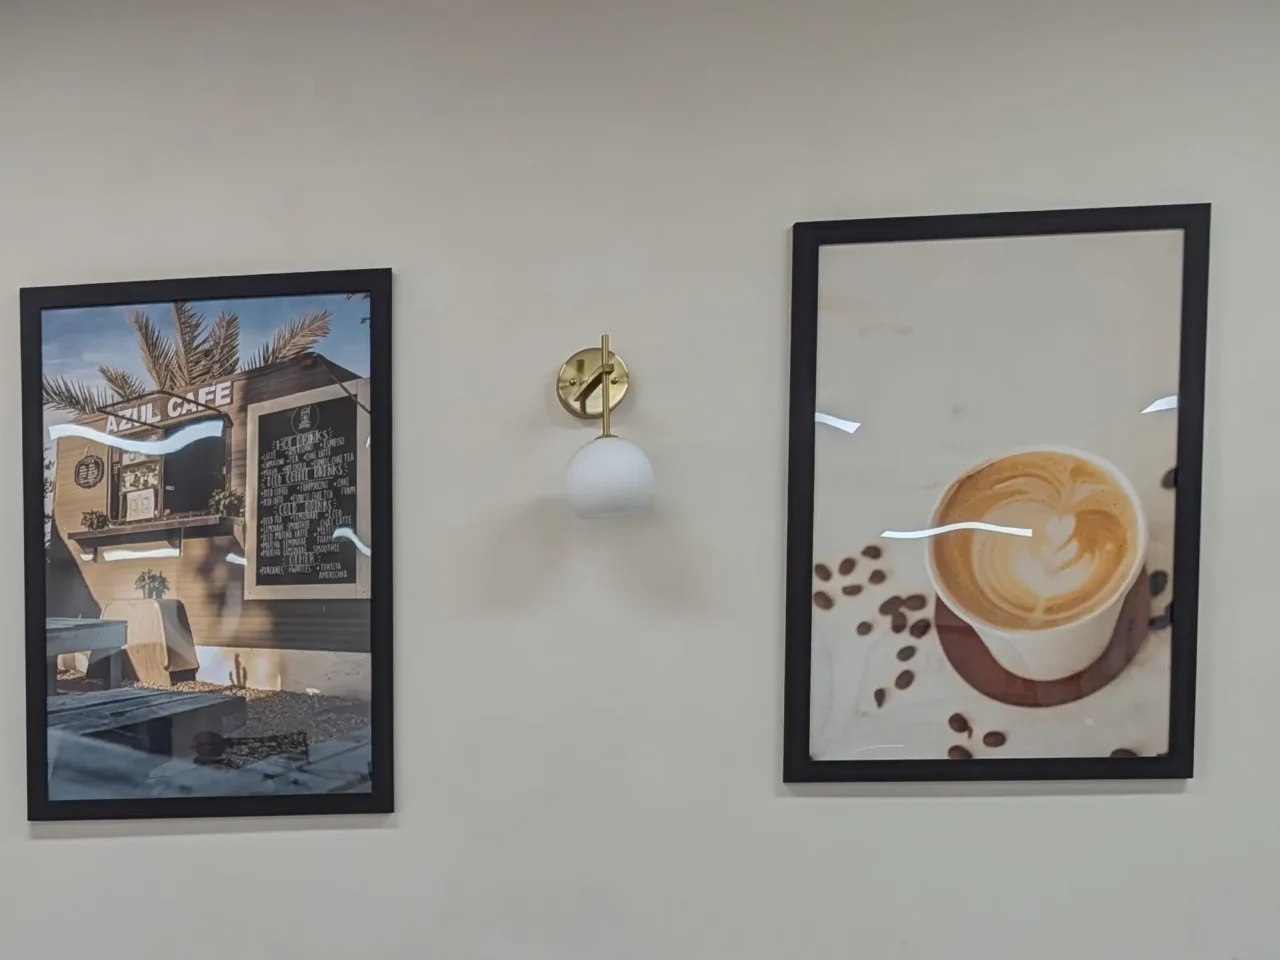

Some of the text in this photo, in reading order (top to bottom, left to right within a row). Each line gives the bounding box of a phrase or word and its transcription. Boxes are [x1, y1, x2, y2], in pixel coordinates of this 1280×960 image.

[105, 380, 232, 434] AZUL CAFE
[276, 429, 329, 451] HOT DRINKS
[313, 464, 343, 478] DRINKS
[279, 500, 333, 516] COLD DRINKS
[289, 553, 315, 565] OTHER
